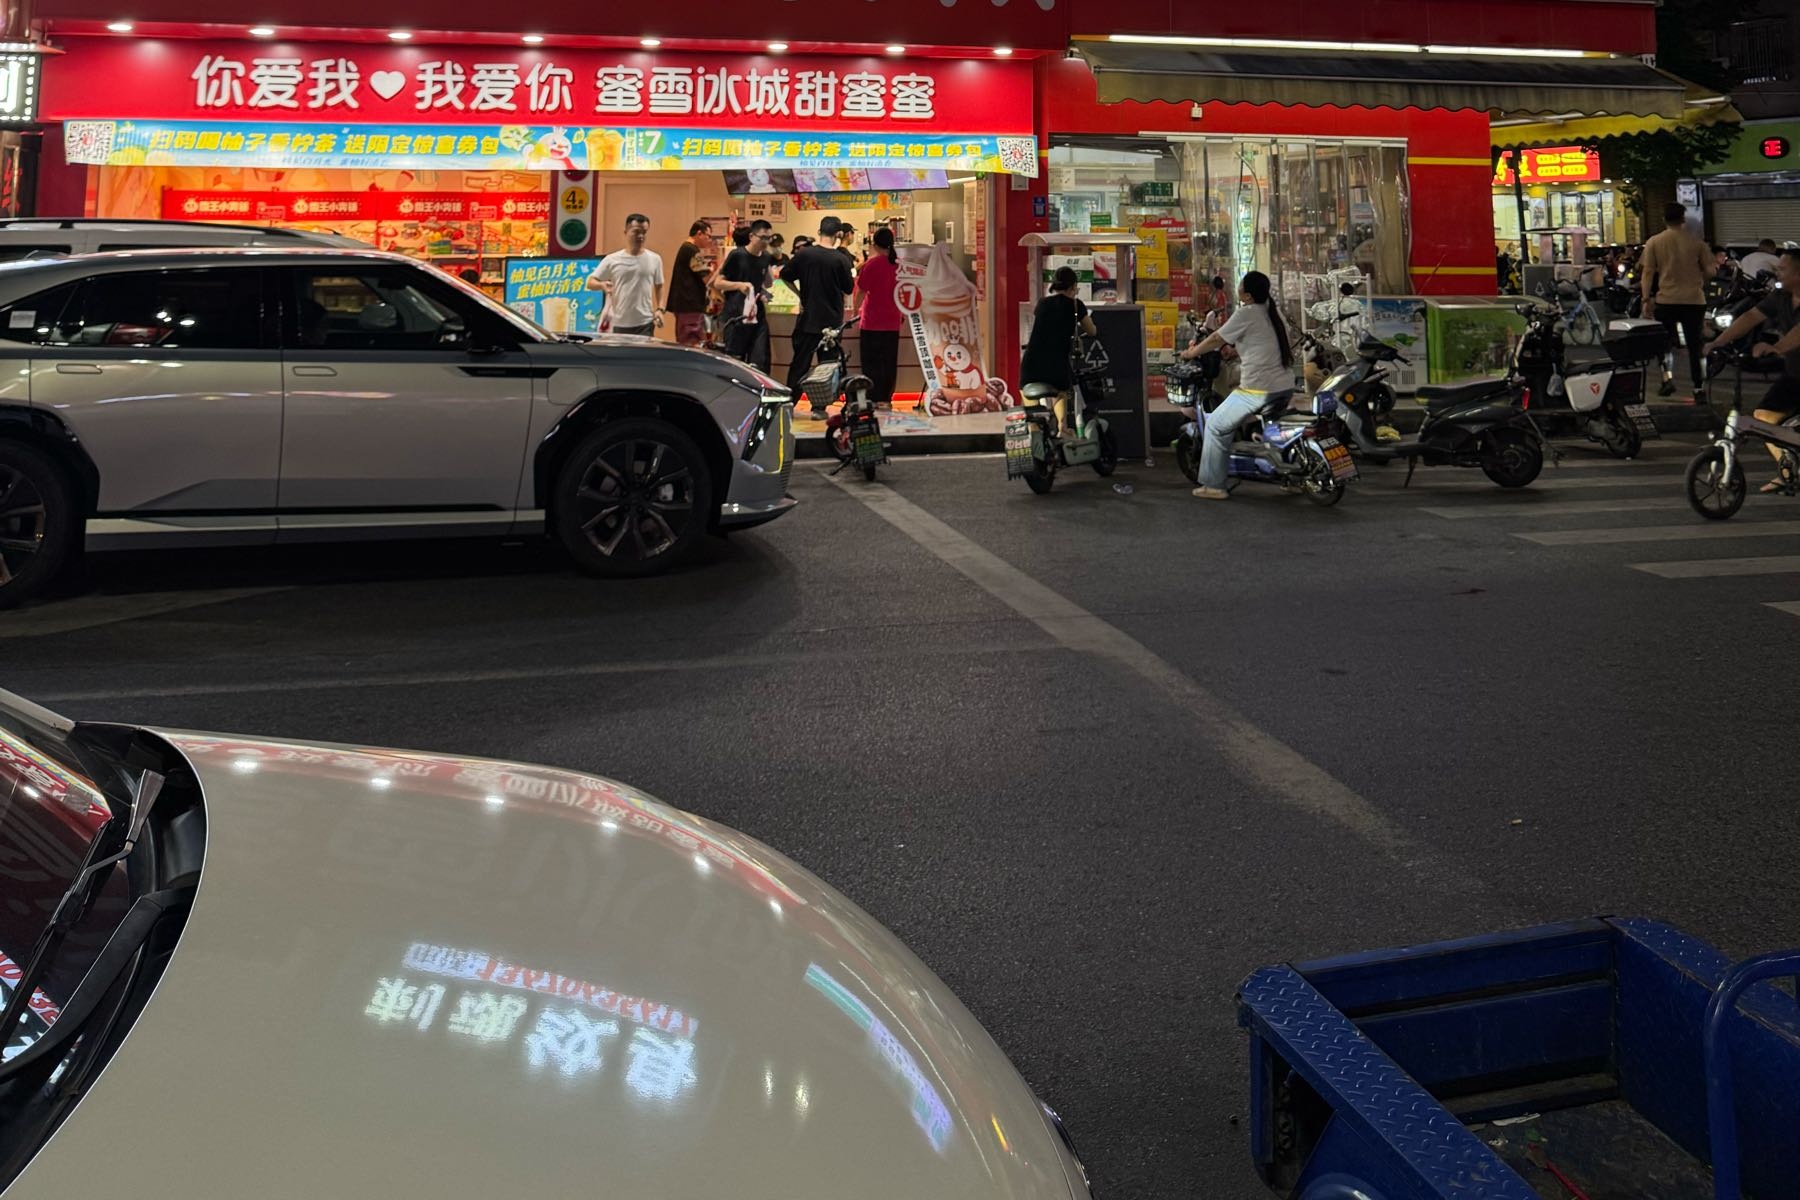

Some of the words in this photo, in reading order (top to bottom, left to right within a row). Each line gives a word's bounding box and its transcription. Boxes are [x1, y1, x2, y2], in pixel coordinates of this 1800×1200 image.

[191, 54, 360, 110] 你爱我
[415, 61, 574, 113] 我爱你
[595, 63, 935, 120] 蜜雪冰城甜蜜蜜
[645, 130, 662, 154] 7
[510, 261, 578, 284] 柚见白月光
[902, 285, 917, 308] 7
